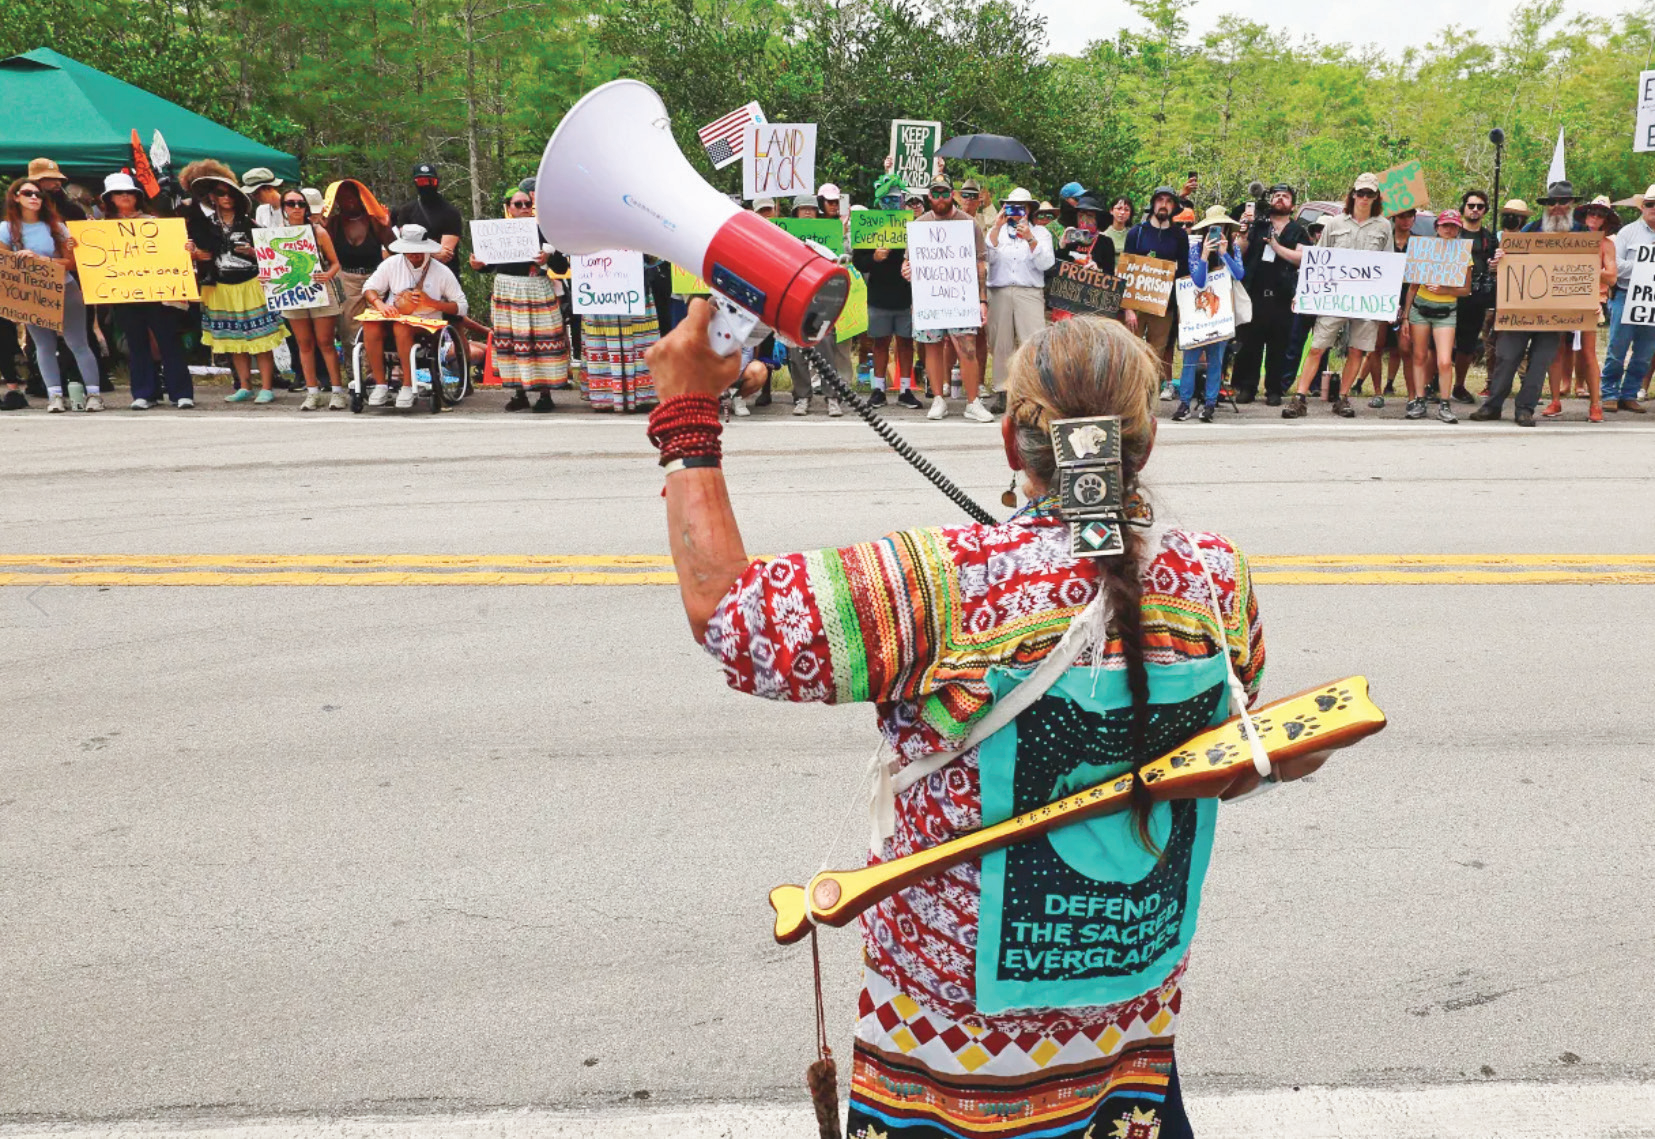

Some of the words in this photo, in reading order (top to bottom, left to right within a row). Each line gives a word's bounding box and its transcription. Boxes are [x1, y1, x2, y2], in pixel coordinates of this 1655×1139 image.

[755, 128, 805, 157] LAND
[901, 126, 930, 143] KEEP
[905, 143, 924, 157] THE
[899, 155, 927, 171] LAND
[755, 156, 806, 193] BACK
[1382, 190, 1415, 217] NO
[117, 221, 158, 238] NO
[859, 214, 884, 228] Save
[888, 213, 907, 229] The
[929, 227, 947, 244] NO
[1503, 238, 1531, 250] ONLY
[256, 246, 276, 261] NO
[915, 245, 955, 261] PRISONS
[960, 244, 973, 259] ON
[1307, 250, 1331, 265] NO
[105, 260, 189, 277] Sanctioned
[260, 267, 271, 277] IN
[915, 266, 972, 284] INDIGENOUS
[1059, 260, 1120, 292] PROTECT
[1306, 266, 1382, 281] PRISONS
[21, 271, 63, 293] Treasure
[1179, 282, 1193, 291] No
[1301, 282, 1338, 295] JUST
[1506, 264, 1549, 302] NO
[1552, 285, 1593, 294] PRISONS
[34, 290, 61, 310] Next
[578, 283, 639, 313] Swamp
[1300, 295, 1397, 313] EVERGLADES
[29, 313, 62, 330] Center
[1045, 893, 1161, 923] DEFEND
[1011, 921, 1073, 945] THE
[1079, 899, 1178, 944] SACRED
[1005, 920, 1180, 969] EVERGLADES
